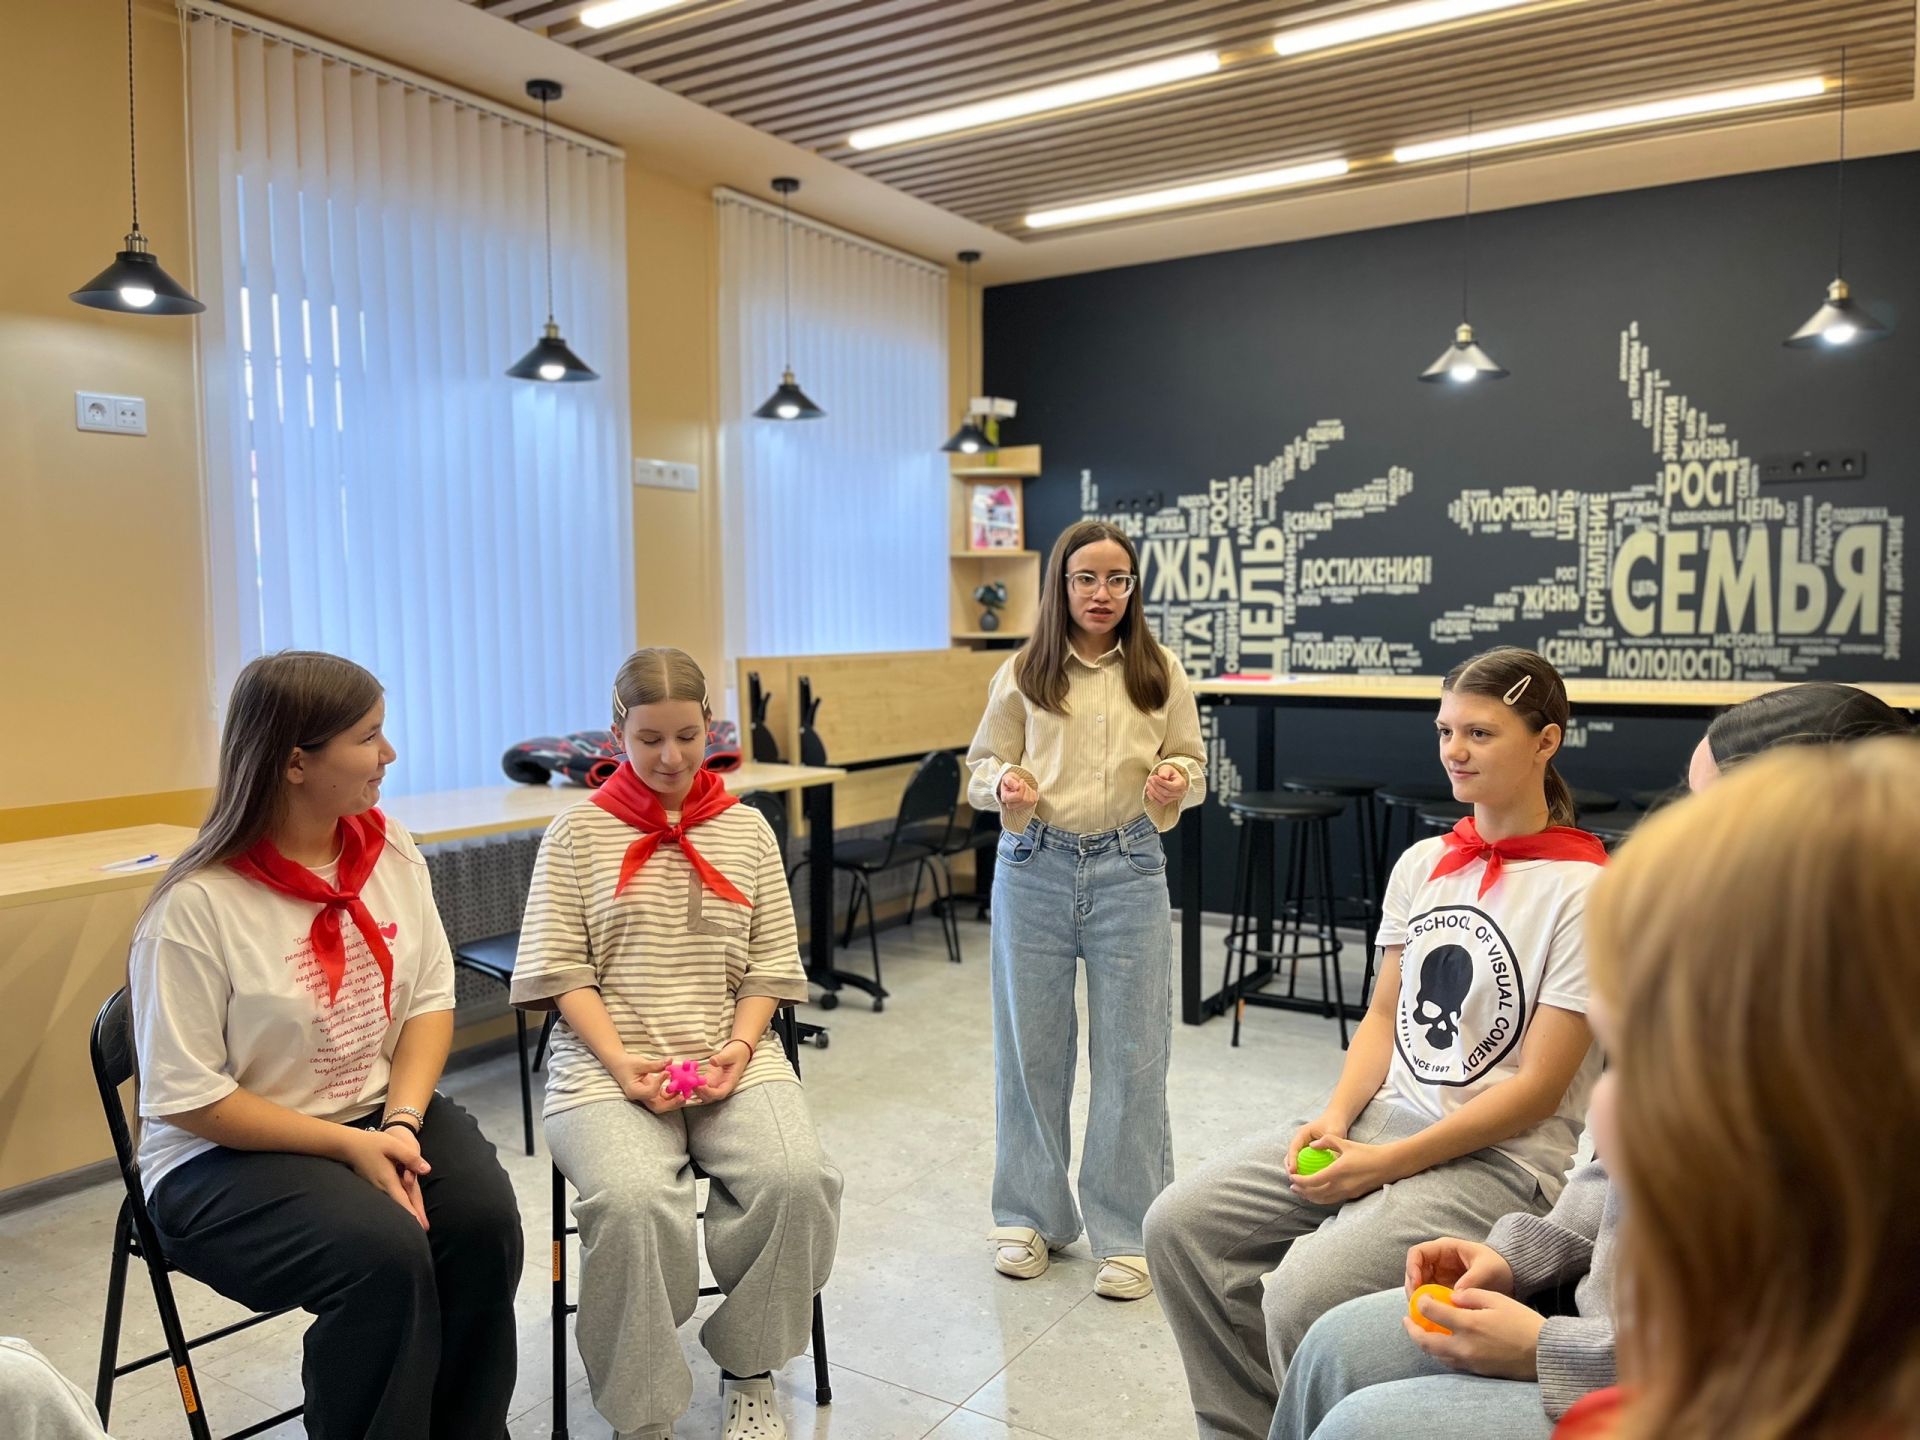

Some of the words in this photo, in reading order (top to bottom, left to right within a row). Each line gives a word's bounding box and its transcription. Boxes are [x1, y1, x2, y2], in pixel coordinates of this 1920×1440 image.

[1662, 395, 1679, 461] ЭНЕРГИЯ
[1681, 438, 1731, 461] ЖИЗНЬ
[1664, 460, 1739, 508] РОСТ
[1209, 478, 1229, 536] РОСТ
[1237, 476, 1253, 545] РАДОСТЬ
[1291, 511, 1332, 531] СЕМЬЯ
[1470, 494, 1550, 522] УПОРСТВО
[1557, 489, 1577, 540] ЦЕЛЬ
[1614, 501, 1660, 519] ДРУЖБА
[1737, 498, 1785, 523] ЦЕЛЬ
[1814, 502, 1833, 566] РАДОСТЬ
[1300, 556, 1424, 589] ДОСТИЖЕНИЯ
[1585, 493, 1608, 625] СТРЕМЛЕНИЕ
[1284, 534, 1297, 624] ПЕРЕМЕНЫ
[1611, 525, 1882, 637] СЕМЬЯ
[1633, 580, 1658, 598] ЦЕЛЬ
[1241, 527, 1290, 674] ЦЕЛЬ
[1522, 585, 1579, 612] ЖИЗНЬ
[1226, 602, 1240, 673] ОБЩЕНИЕ
[1546, 638, 1603, 667] СЕМЬЯ
[1292, 642, 1391, 670] ПОДДЕРЖКА
[1606, 648, 1731, 681] МОЛОДОСТЬ
[1414, 915, 1471, 937] SCHOOL
[1475, 926, 1493, 944] OF
[1487, 943, 1513, 1011] VISUAL
[1462, 1016, 1511, 1076] COMEDY
[1431, 1065, 1450, 1074] 1997
